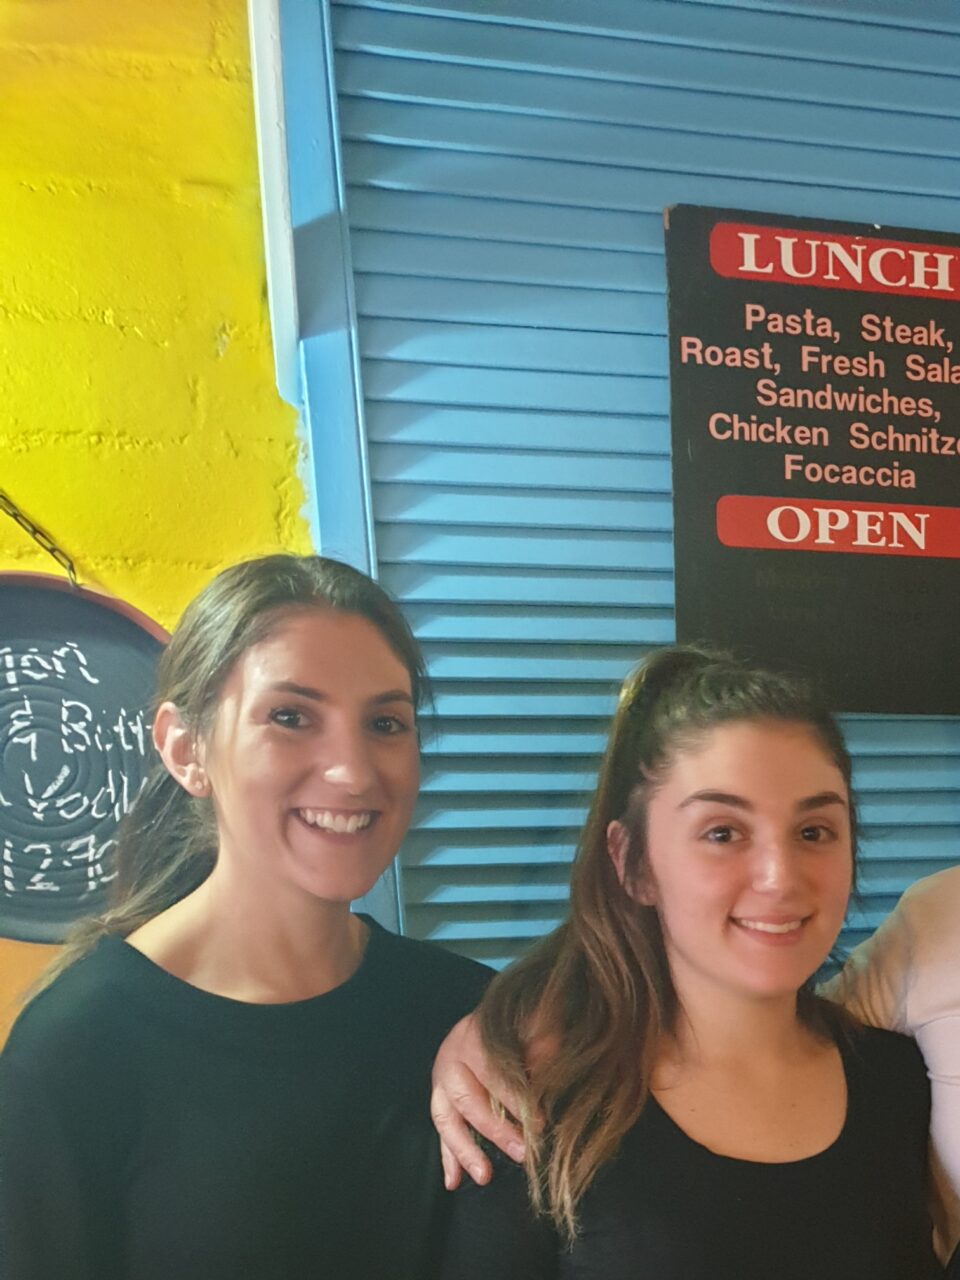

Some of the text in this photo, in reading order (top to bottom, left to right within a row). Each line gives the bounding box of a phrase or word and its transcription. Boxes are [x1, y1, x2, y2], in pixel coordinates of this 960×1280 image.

[737, 232, 956, 292] LUNCH
[744, 304, 954, 353] Pasta, Steak,
[680, 336, 782, 375] Roast,
[801, 346, 886, 378] Fresh
[756, 379, 942, 422] Sandwiches,
[708, 413, 830, 447] Chicken
[784, 454, 917, 489] Focaccia
[766, 505, 930, 550] OPEN
